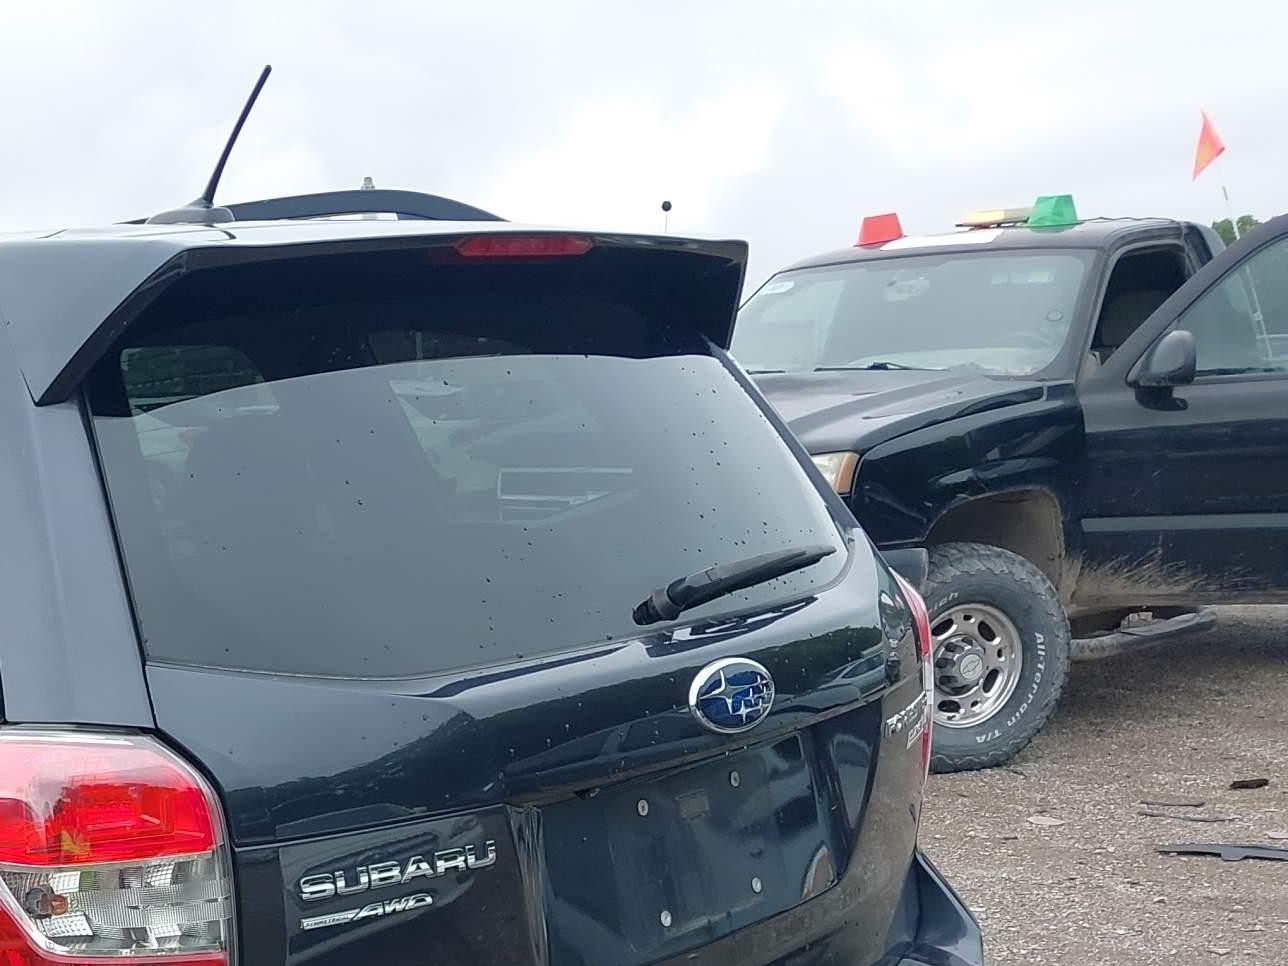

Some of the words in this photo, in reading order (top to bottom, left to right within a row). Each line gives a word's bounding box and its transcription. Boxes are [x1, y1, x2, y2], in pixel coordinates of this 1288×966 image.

[1007, 631, 1047, 727] All-Terrain
[975, 730, 1003, 744] T/A
[299, 839, 497, 902] SUBARU
[352, 893, 433, 921] AWD
